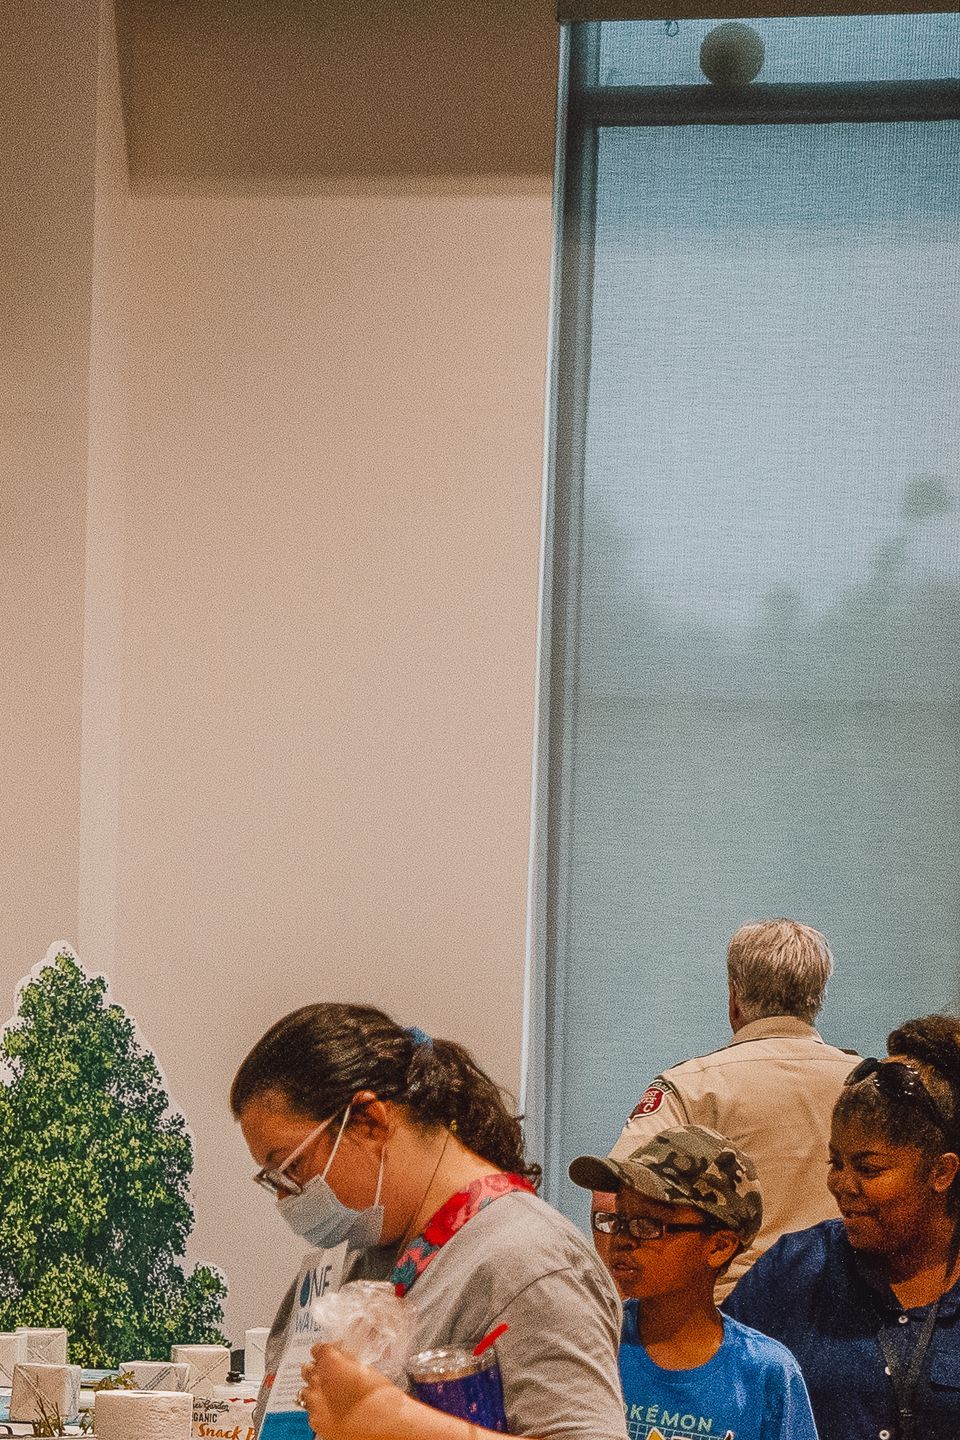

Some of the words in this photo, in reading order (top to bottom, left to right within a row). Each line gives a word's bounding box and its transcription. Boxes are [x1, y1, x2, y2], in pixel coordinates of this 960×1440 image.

[192, 1412, 218, 1423] GANIC
[623, 1403, 713, 1433] KÉMON
[198, 1423, 243, 1440] Snack
